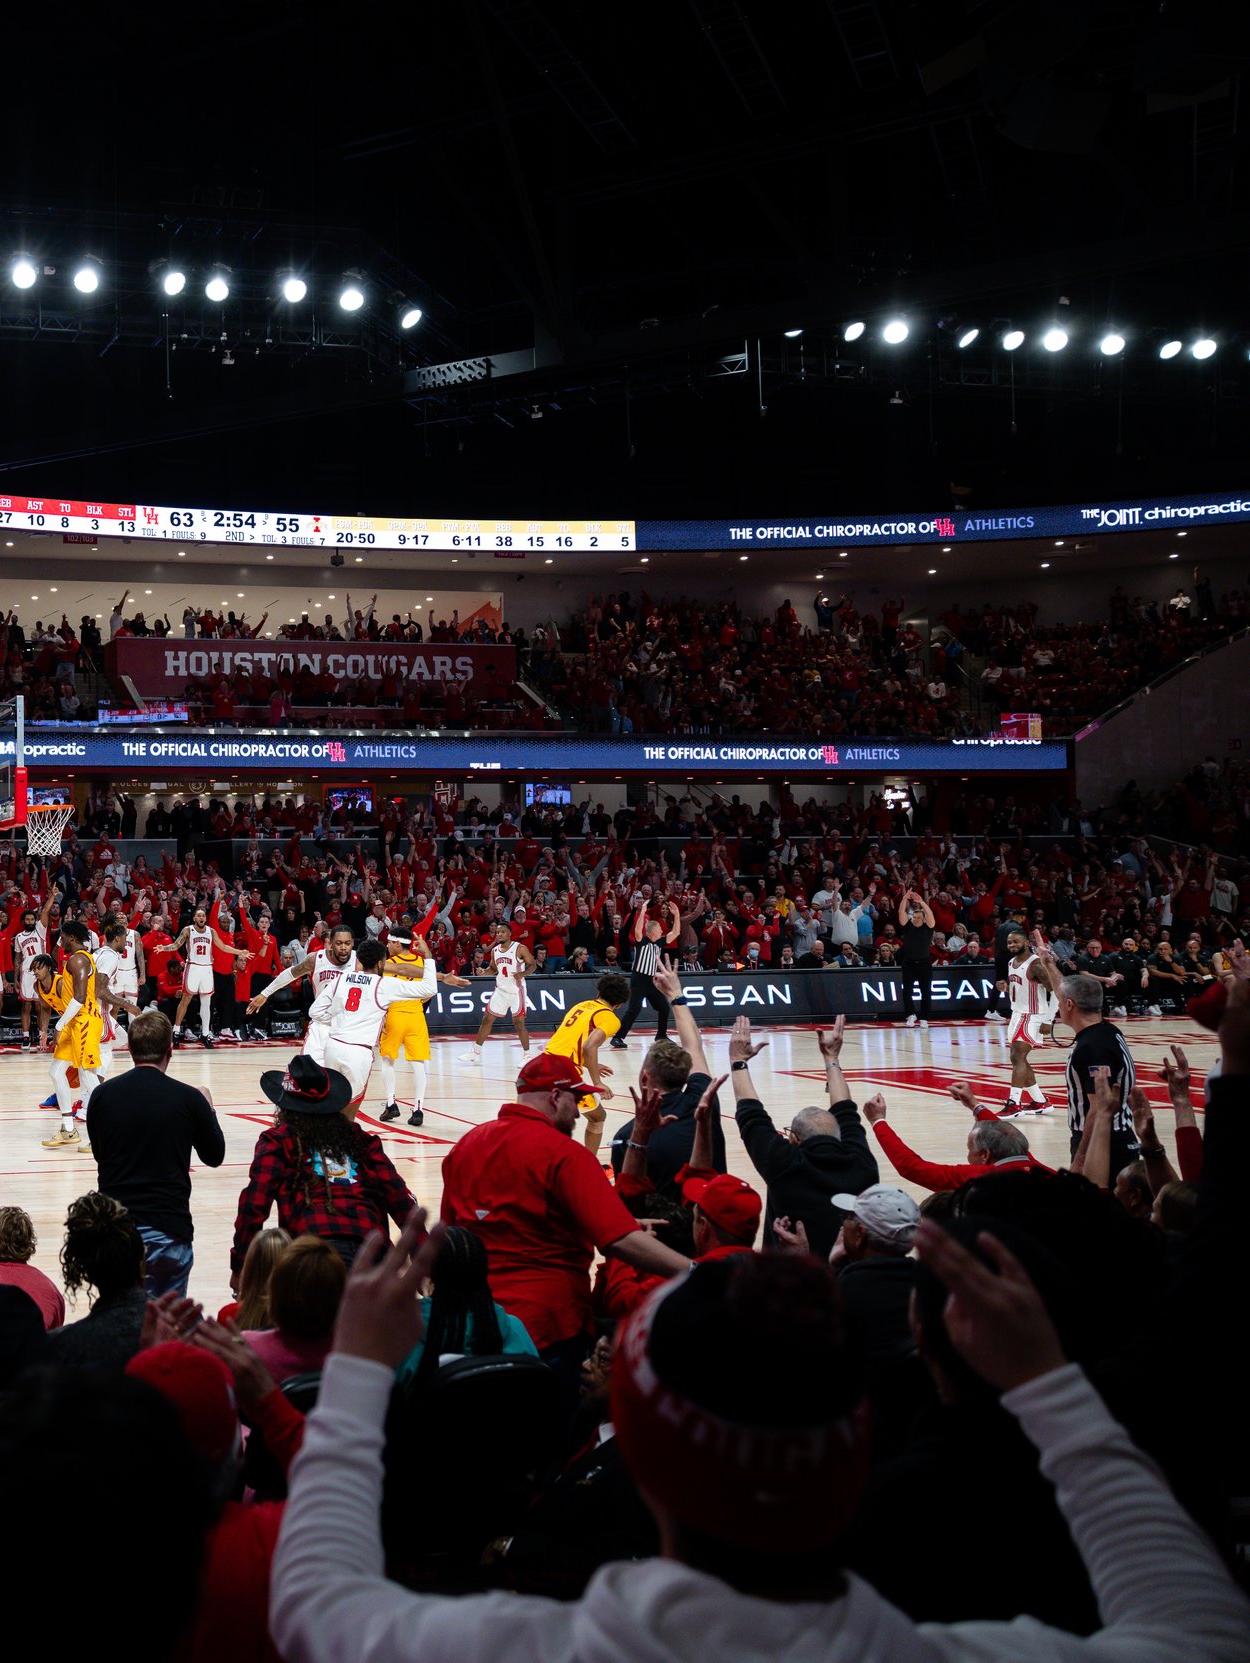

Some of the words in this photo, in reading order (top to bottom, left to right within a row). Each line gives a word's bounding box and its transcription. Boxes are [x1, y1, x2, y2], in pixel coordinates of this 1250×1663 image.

[27, 500, 43, 511] AST
[60, 503, 70, 513] TO
[87, 505, 103, 515] BLK
[118, 507, 133, 517] STL
[1081, 508, 1100, 519] THE
[1144, 500, 1250, 519] chiropractic
[28, 514, 45, 526] 10
[61, 517, 69, 528] 8
[91, 519, 99, 530] 3
[118, 520, 135, 533] 13
[170, 511, 194, 528] 63
[213, 511, 257, 528] 2:54
[276, 517, 300, 533] 55
[730, 528, 753, 540] THE
[756, 525, 812, 539] OFFICIAL
[814, 521, 916, 537] CHIROPRACTOR
[919, 520, 937, 534] OF
[964, 516, 1034, 532] ATHLETICS
[162, 530, 167, 538] 1
[200, 532, 206, 540] 9
[225, 531, 244, 541] 2ND
[281, 536, 287, 544] 3
[336, 532, 375, 544] 20-50
[398, 534, 429, 546] 9-17
[452, 535, 481, 547] 6-11
[495, 536, 513, 547] 38
[527, 536, 544, 547] 15
[555, 536, 573, 547] 16
[590, 537, 598, 547] 2
[621, 537, 629, 547] 5
[164, 650, 320, 679] HOUSTON
[327, 654, 474, 682] COUGARS
[122, 742, 146, 756] THE
[150, 743, 207, 757] OFFICIAL
[209, 743, 309, 757] CHIROPRACTOR
[311, 744, 328, 757] OF
[354, 745, 417, 758] ATHLETICS
[644, 747, 665, 760] THE
[668, 746, 718, 760] OFFICIAL
[720, 747, 806, 761] CHIROPRACTOR
[808, 747, 824, 760] OF
[846, 747, 900, 761] ATHLETICS
[26, 945, 36, 956] 11
[196, 945, 206, 955] 21
[346, 974, 371, 985] WILSON
[502, 967, 508, 977] 4
[345, 987, 362, 1012] 8
[565, 1009, 584, 1027] 5
